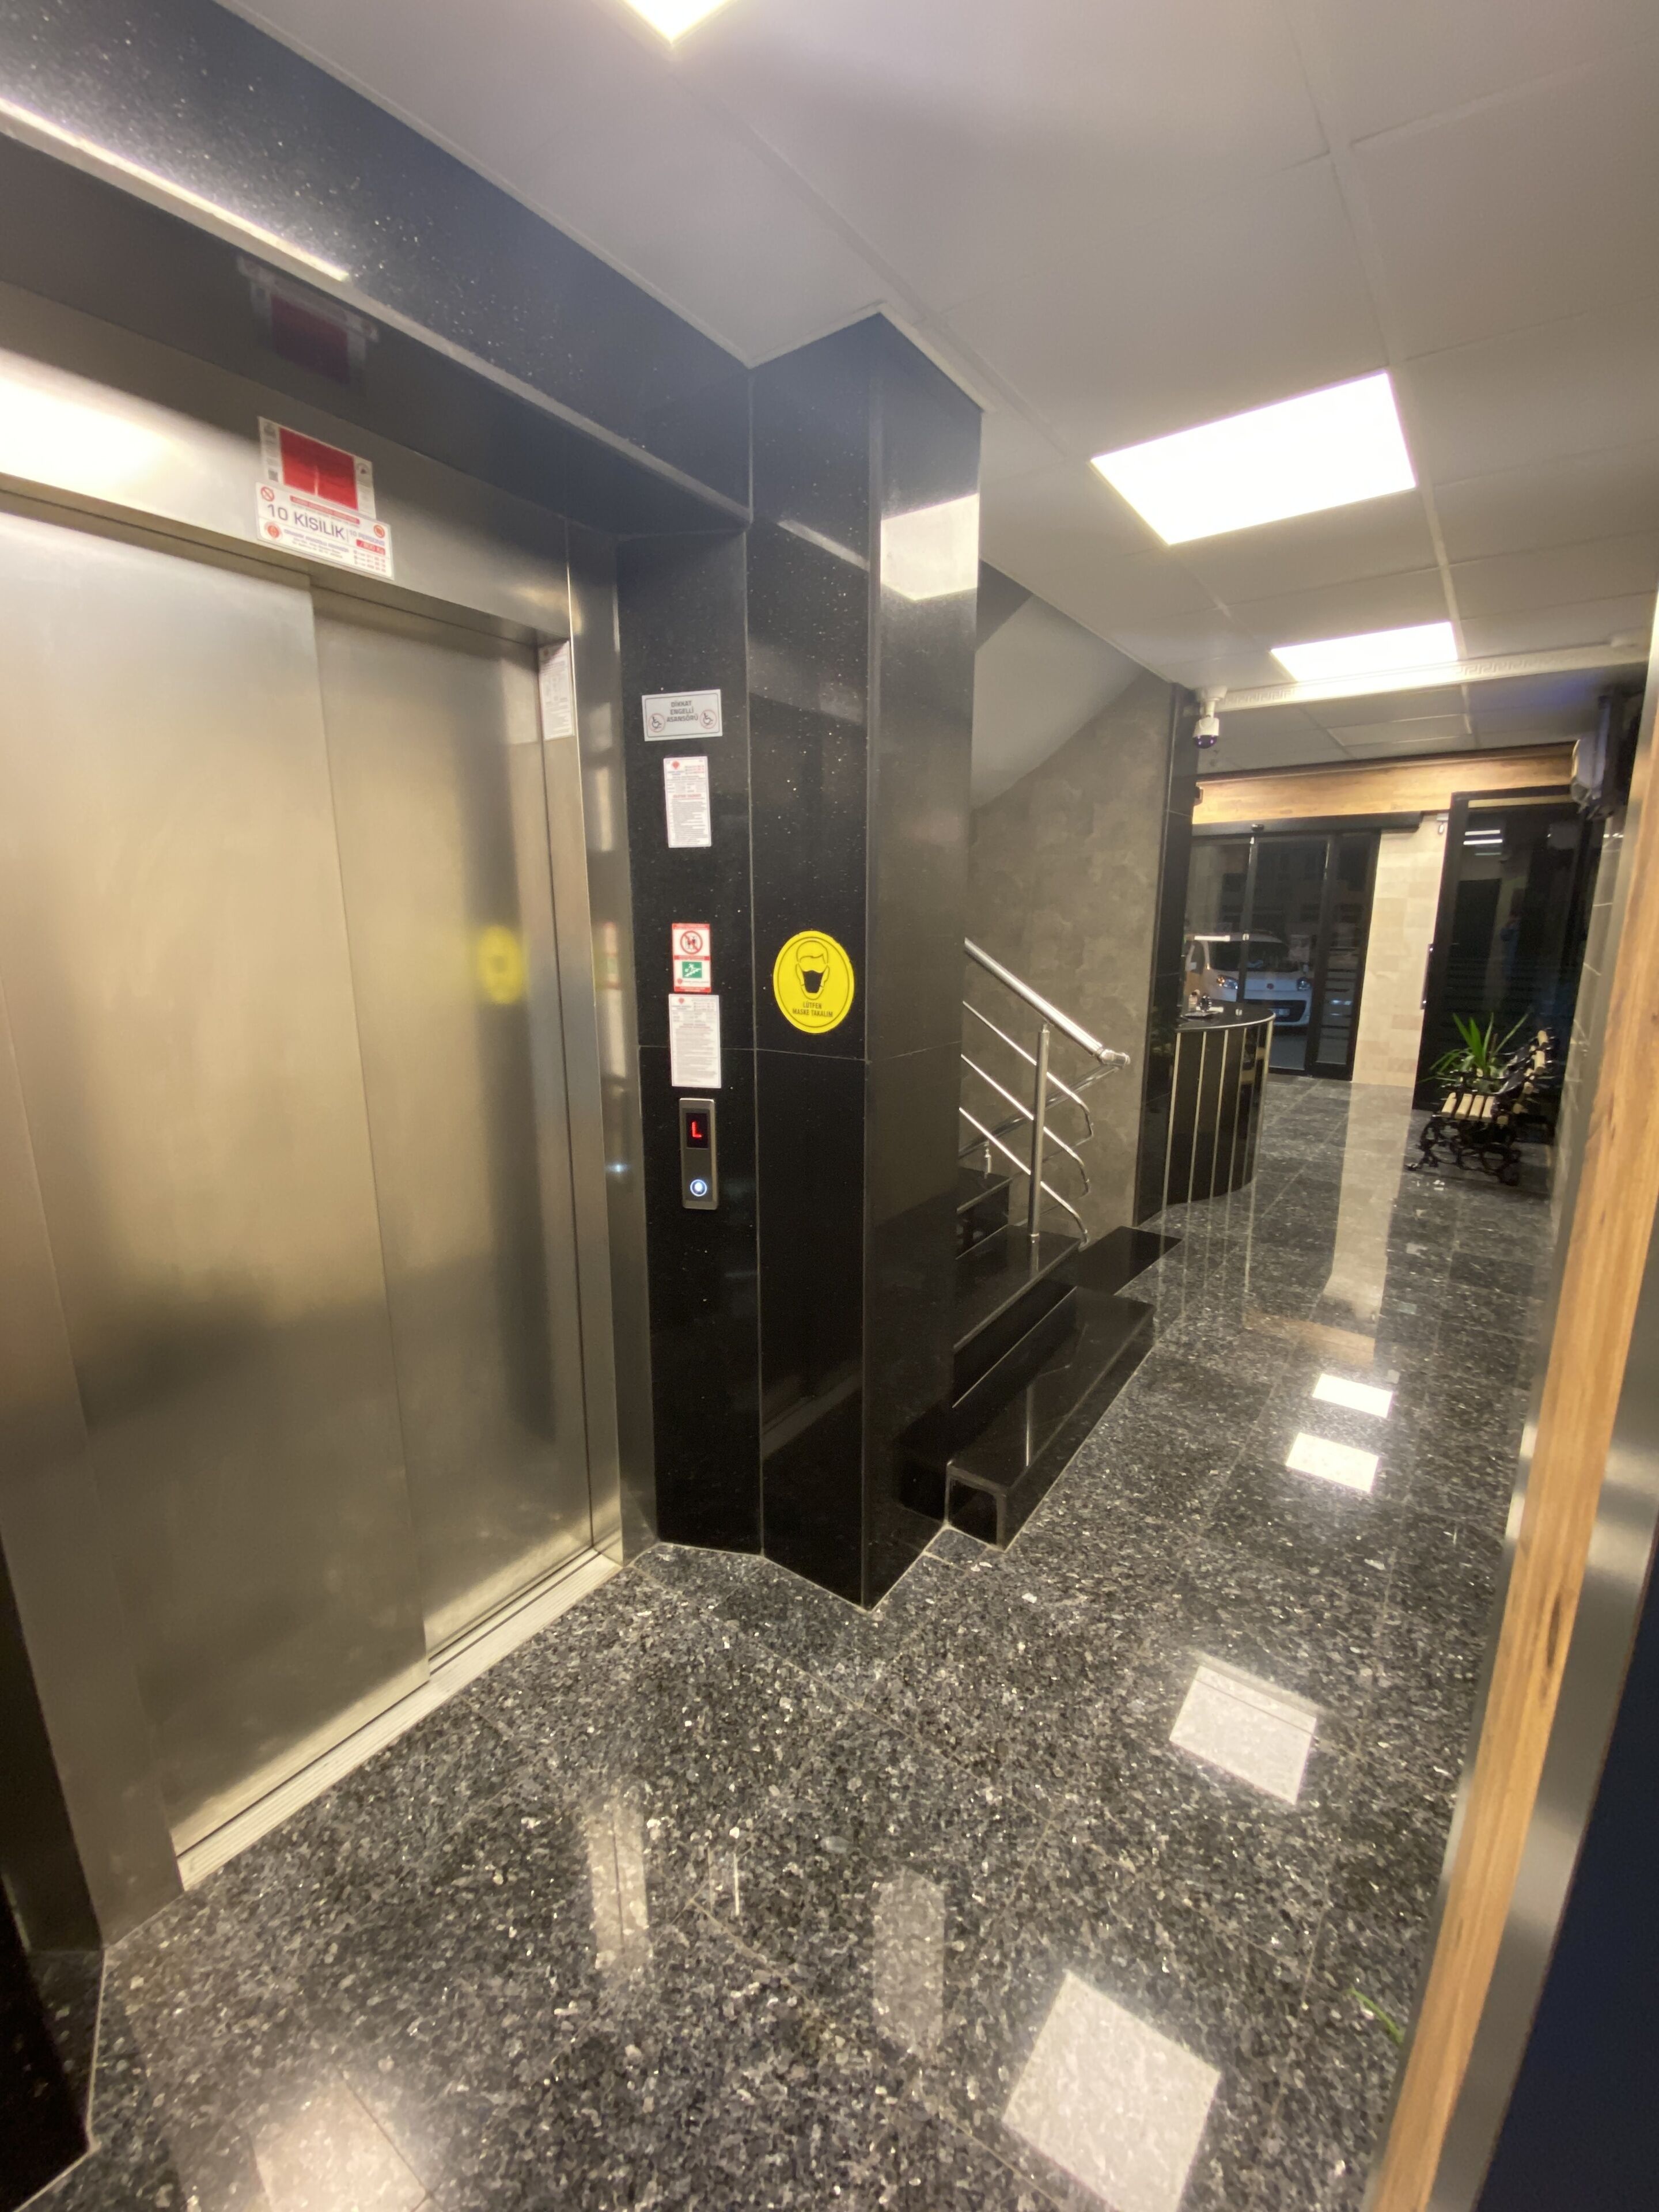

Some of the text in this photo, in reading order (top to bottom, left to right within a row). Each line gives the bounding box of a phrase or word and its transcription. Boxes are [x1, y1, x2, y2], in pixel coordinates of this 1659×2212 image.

[267, 504, 288, 521] 10
[670, 706, 694, 715] ENGELLİ
[666, 714, 699, 722] ASANSÖRÜ
[803, 1001, 822, 1009] LÜTFEN
[811, 1009, 833, 1017] TAKALIM
[692, 1122, 702, 1138] L
